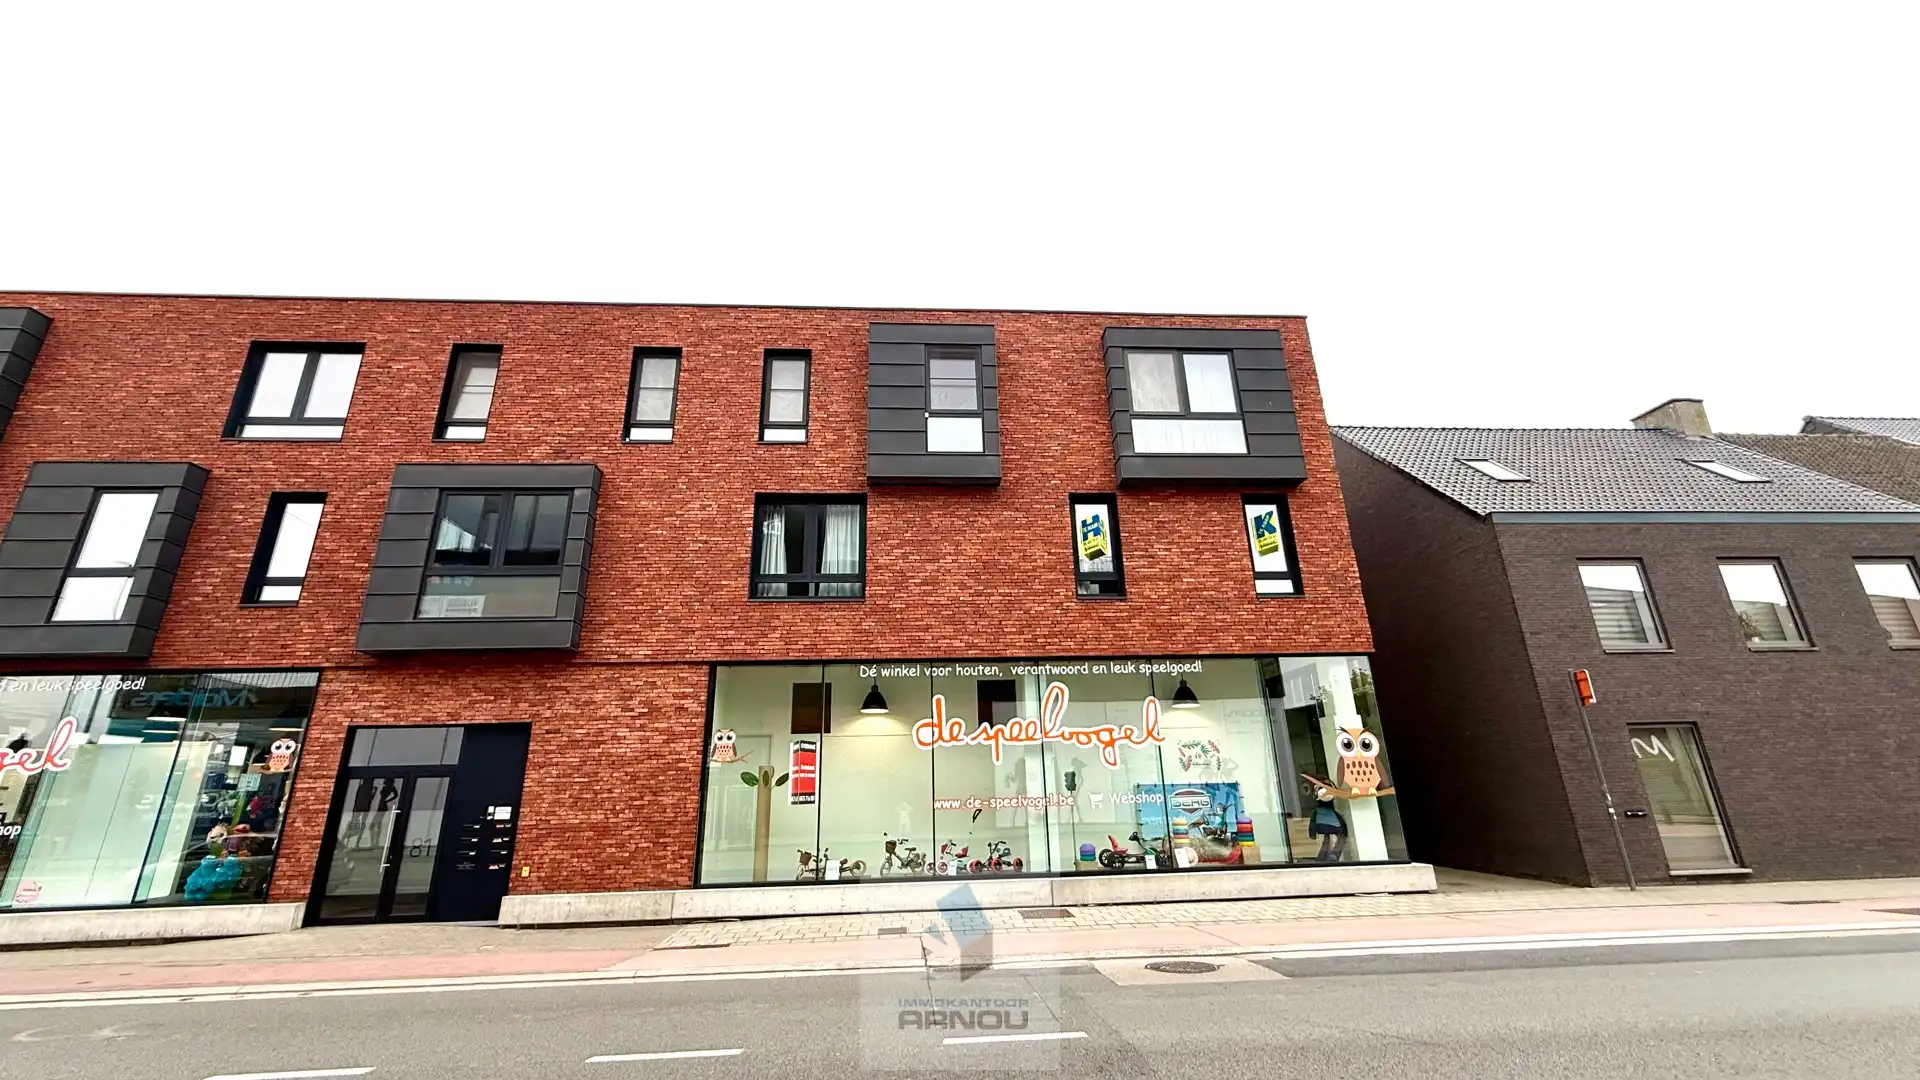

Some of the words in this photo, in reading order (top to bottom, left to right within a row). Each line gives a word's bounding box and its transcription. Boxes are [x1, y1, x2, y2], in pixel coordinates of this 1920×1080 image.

[859, 664, 877, 677] Dé
[881, 665, 920, 677] winkel
[924, 664, 952, 677] voor
[955, 663, 1003, 677] houten,
[1010, 662, 1089, 676] verantwoord
[1092, 664, 1108, 675] en
[1110, 660, 1136, 674] leuk
[1138, 660, 1202, 676] speelgoed!
[914, 696, 967, 747] de
[968, 684, 1166, 767] speelvogel
[933, 794, 1075, 812] www.de-speelvogel.be
[1108, 791, 1164, 806] Webshop
[409, 838, 432, 857] 81
